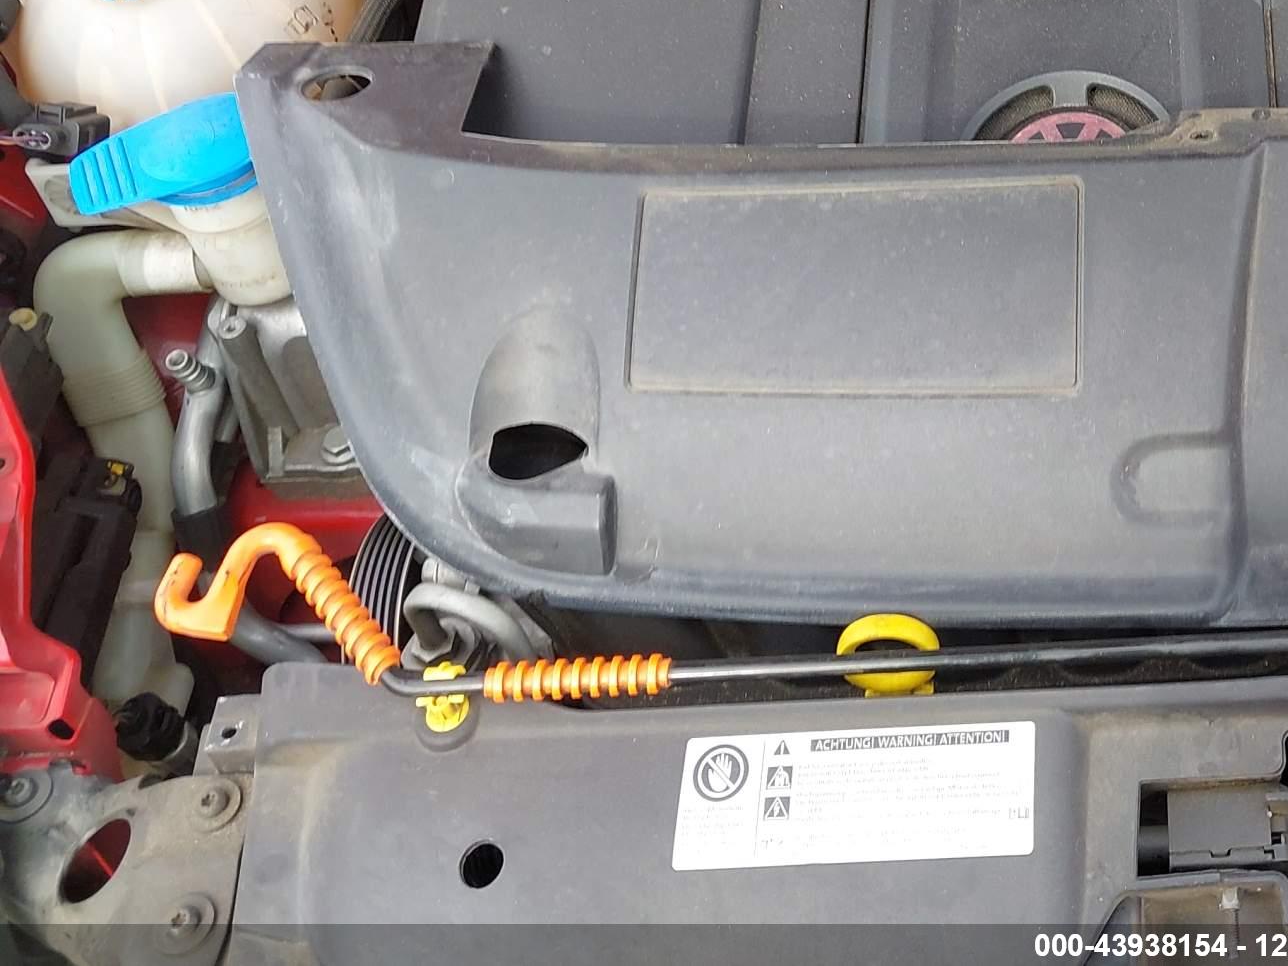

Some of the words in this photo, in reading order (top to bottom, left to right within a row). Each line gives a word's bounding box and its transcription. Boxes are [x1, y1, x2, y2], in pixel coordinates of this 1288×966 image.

[815, 736, 875, 752] ACHTUNG!
[877, 733, 937, 748] WARNING!
[939, 731, 1006, 746] ATTENTION!
